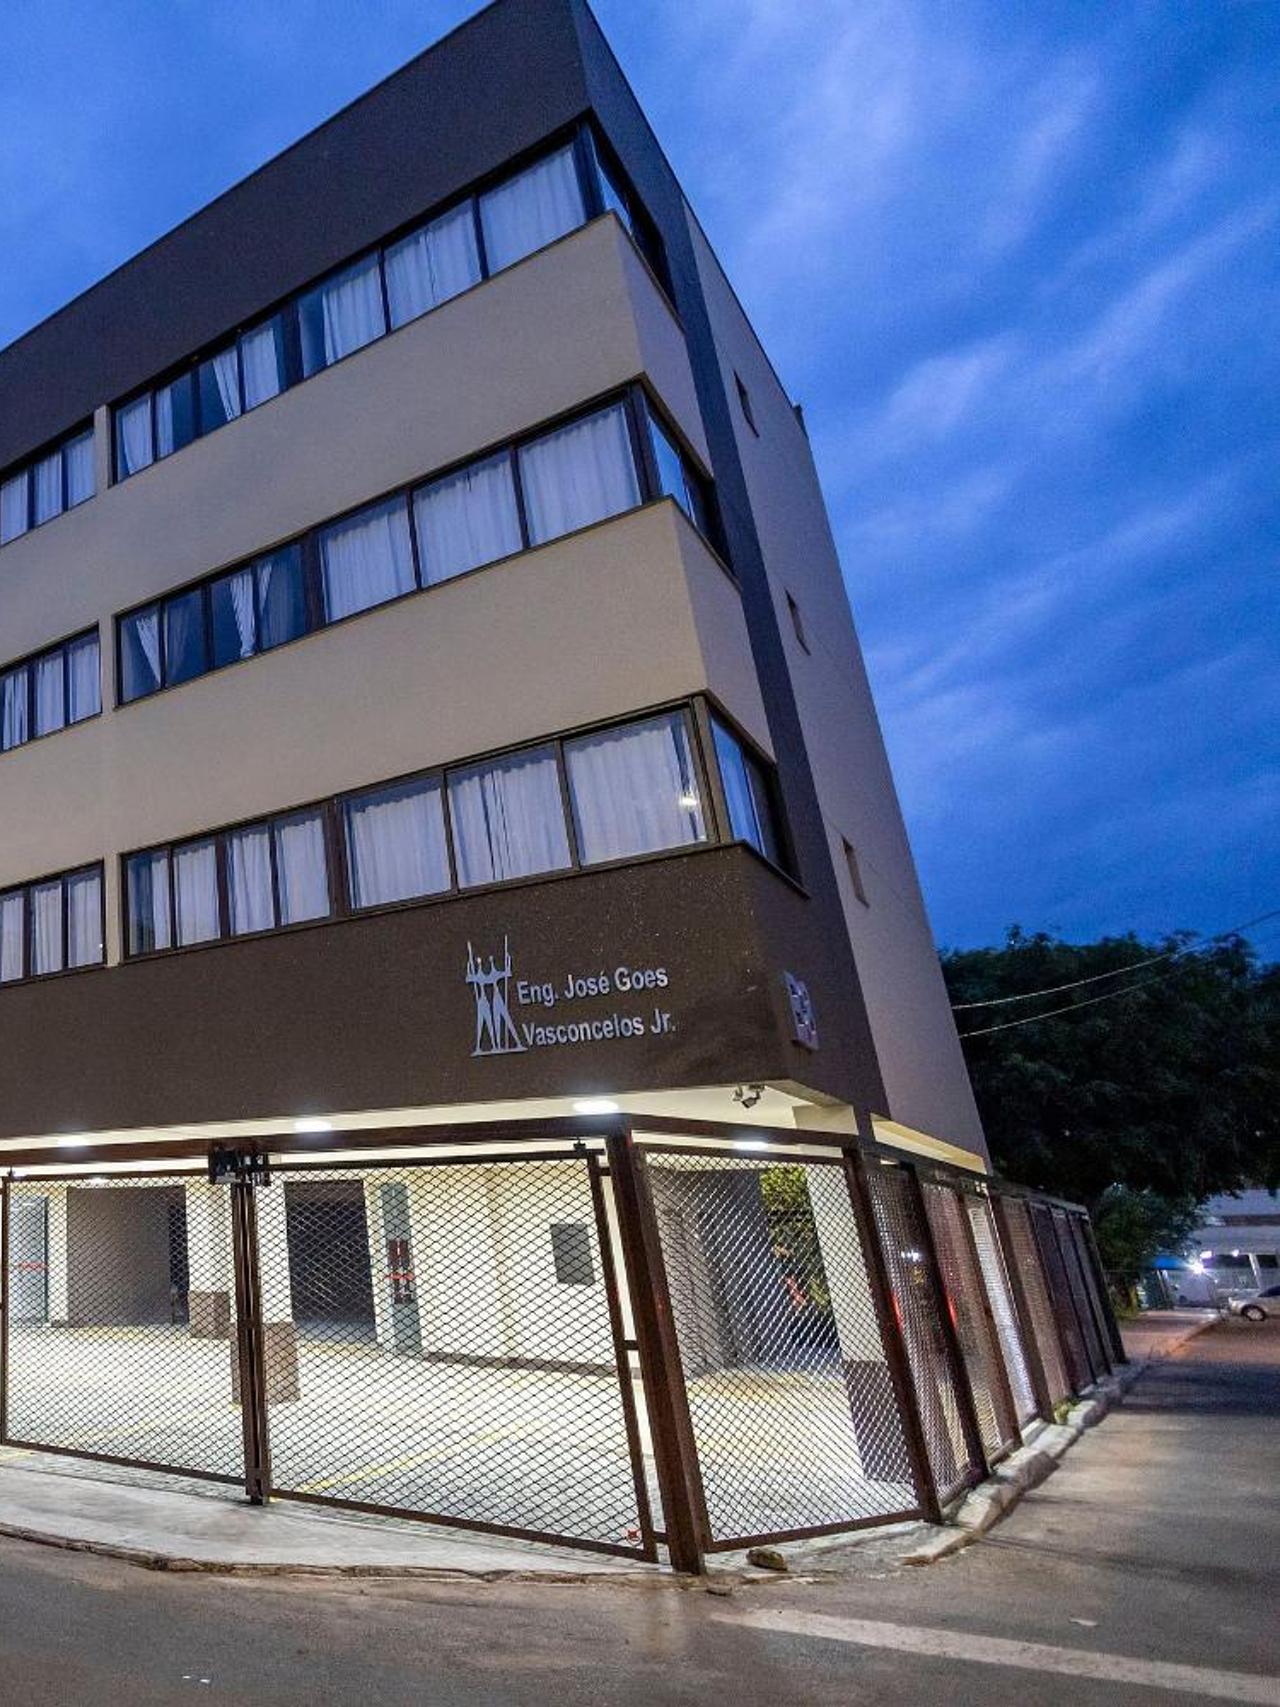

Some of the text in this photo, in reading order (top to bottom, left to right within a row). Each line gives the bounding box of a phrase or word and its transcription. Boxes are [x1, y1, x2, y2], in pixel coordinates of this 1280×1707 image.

[517, 966, 669, 1007] Eng. José Goes
[522, 1008, 676, 1046] Vasconcelos Jr.
